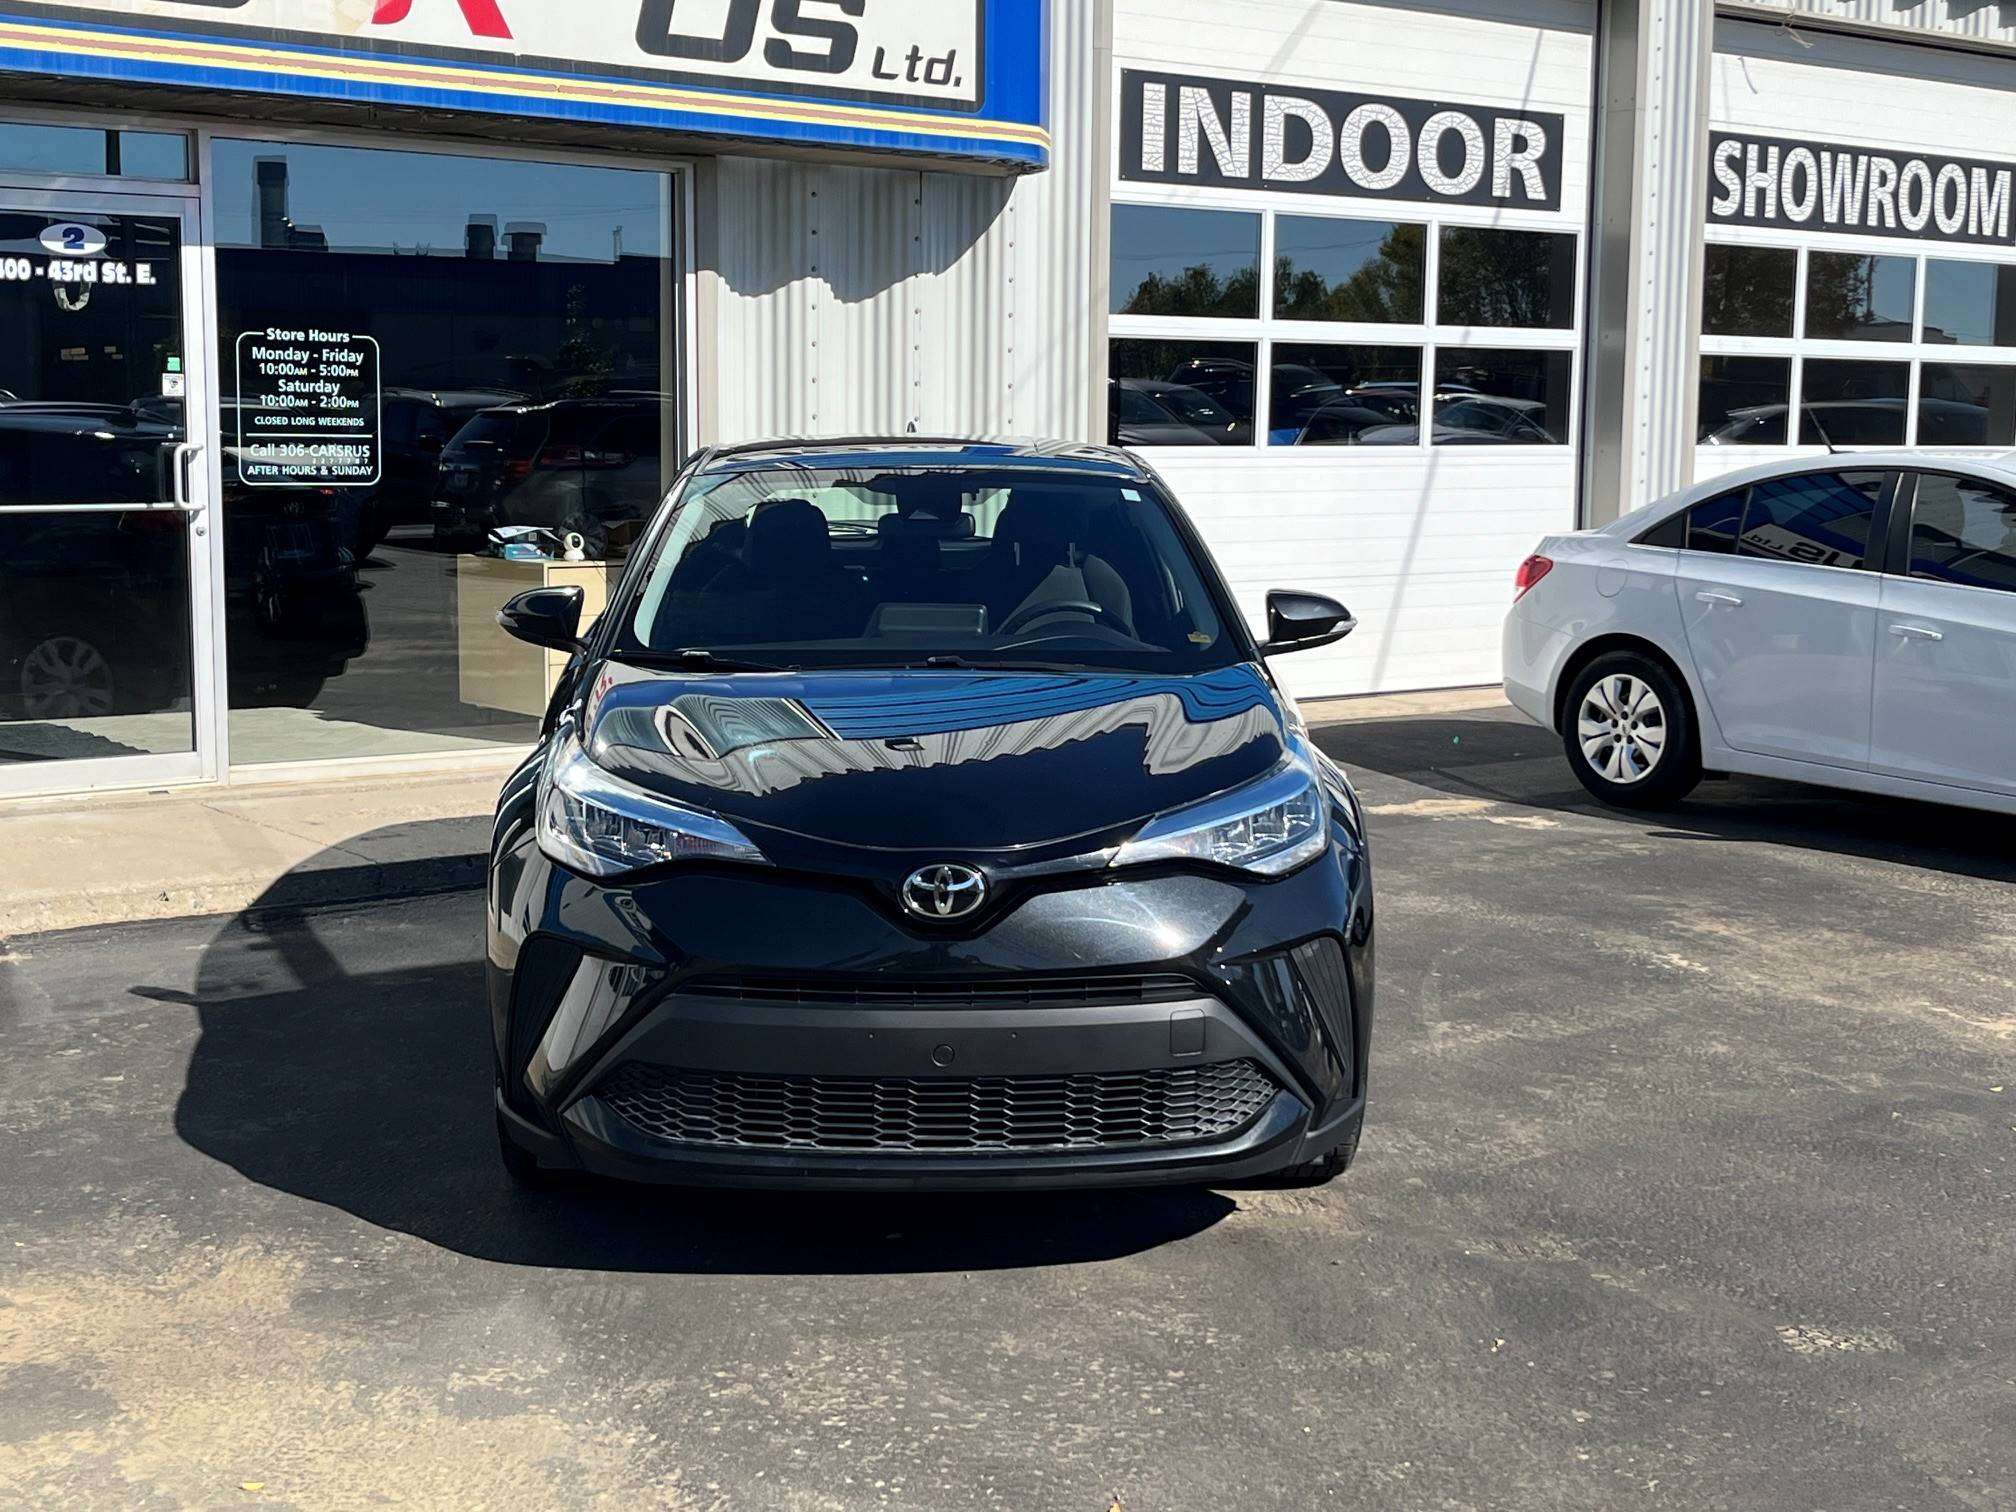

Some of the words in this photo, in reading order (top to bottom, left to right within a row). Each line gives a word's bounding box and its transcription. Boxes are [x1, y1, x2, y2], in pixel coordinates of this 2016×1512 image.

[871, 45, 962, 87] Ltd.
[1141, 82, 1547, 200] INDOOR
[1712, 139, 2012, 238] SHOWROOM
[62, 227, 85, 249] 2
[48, 259, 98, 282] 43rd
[101, 261, 132, 284] St.
[135, 262, 157, 285] E.
[266, 328, 306, 341] Store
[308, 329, 350, 342] Hours
[252, 346, 310, 364] Monday
[322, 348, 364, 366] Friday
[278, 379, 340, 396] Saturday
[254, 416, 288, 425] CLOSED
[291, 417, 316, 426] LONG
[318, 417, 365, 427] WEEKENDS
[250, 443, 275, 457] Call
[280, 444, 370, 458] 306-CARSRUS
[247, 466, 279, 475] AFTER
[281, 466, 317, 475] HOURS
[320, 466, 329, 475] &
[332, 466, 373, 476] SUNDAY
